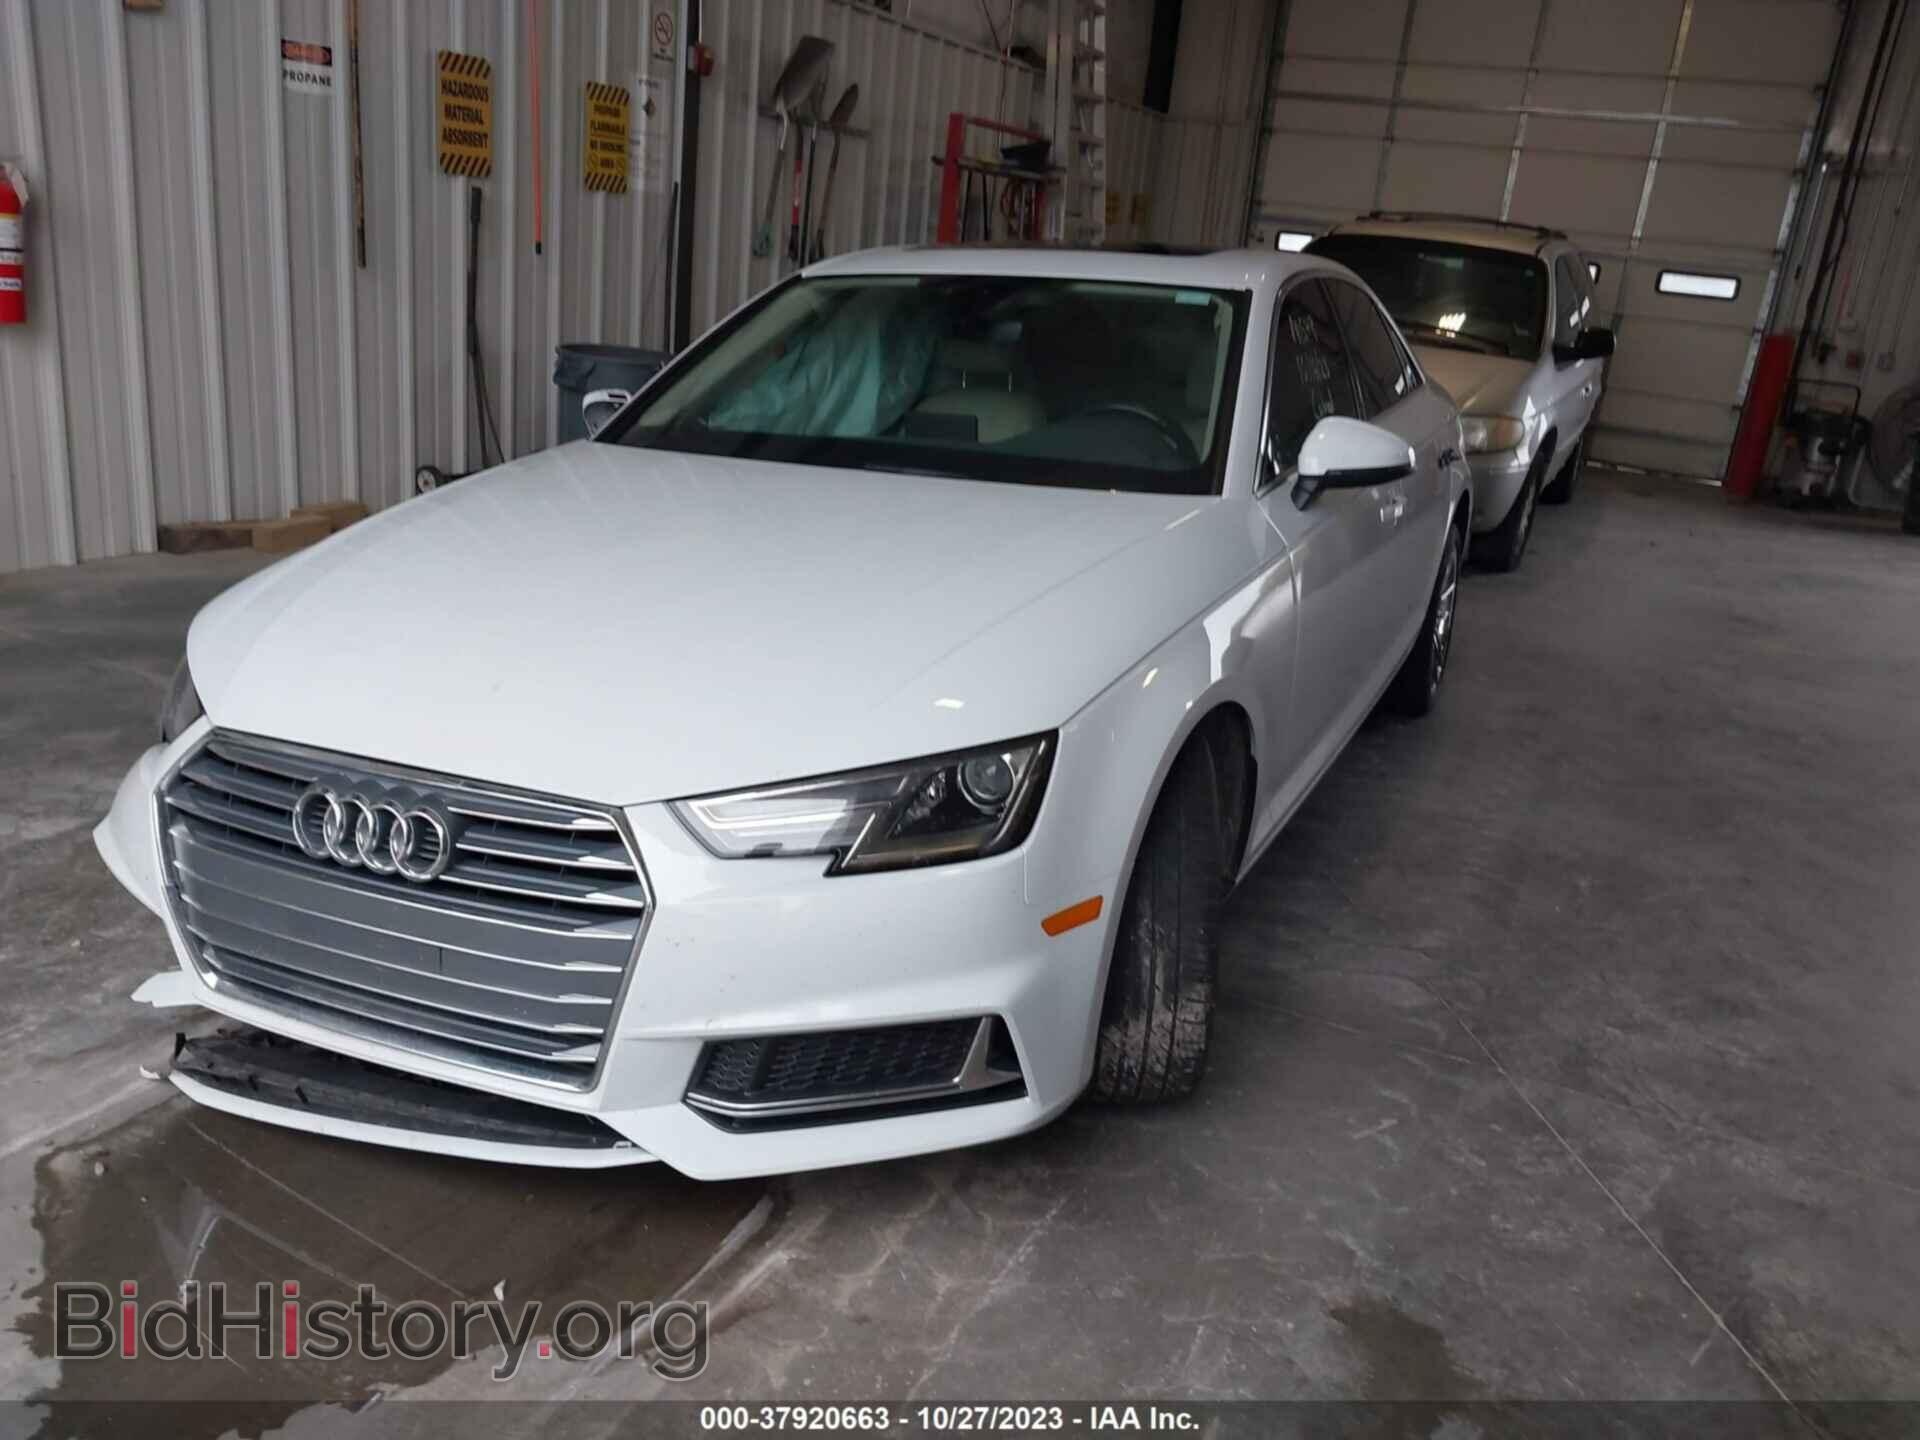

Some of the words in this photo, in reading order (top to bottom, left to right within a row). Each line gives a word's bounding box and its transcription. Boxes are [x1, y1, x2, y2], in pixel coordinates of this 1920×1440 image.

[282, 69, 332, 87] PROPANE
[441, 79, 489, 103] HAZARDOUS
[444, 103, 484, 125] MATERIAL
[442, 127, 489, 149] ABSORBENT
